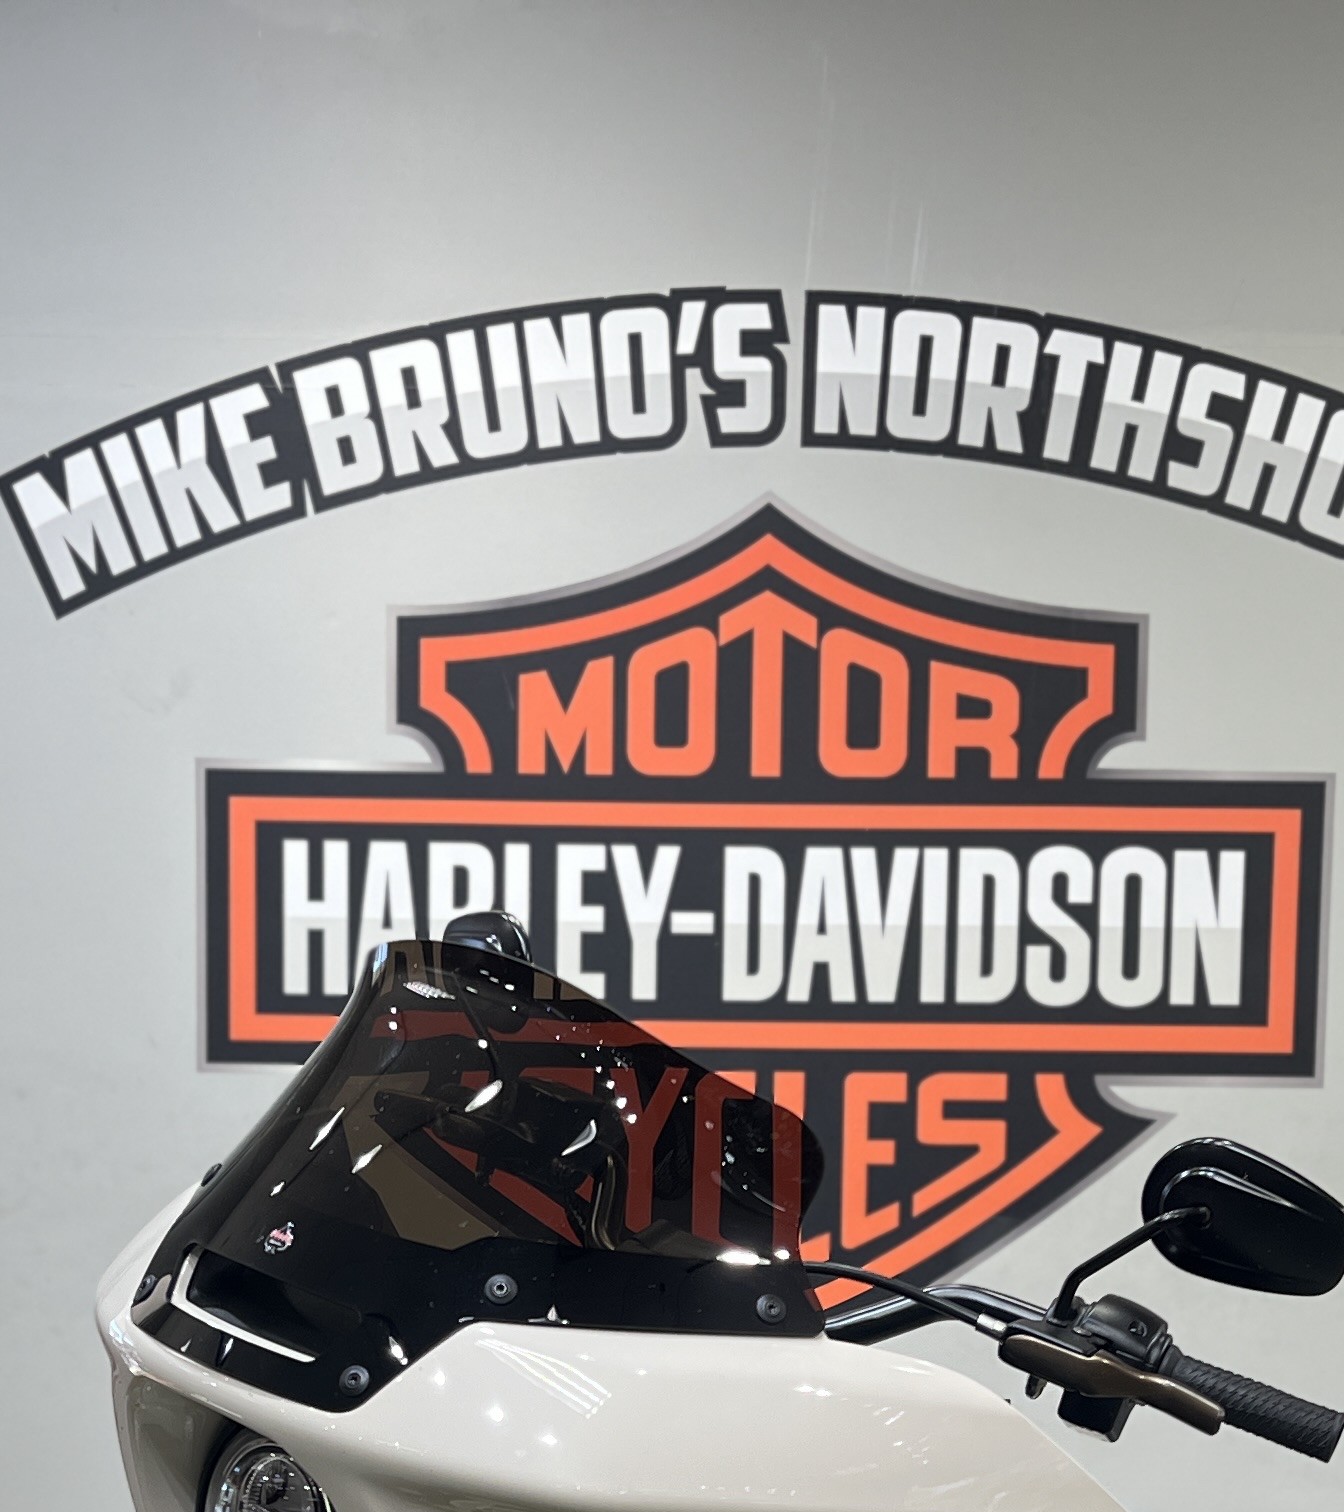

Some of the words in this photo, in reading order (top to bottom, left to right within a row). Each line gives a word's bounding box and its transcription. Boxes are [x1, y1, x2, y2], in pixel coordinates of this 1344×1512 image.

[11, 381, 294, 602] MIKE
[291, 300, 778, 498] BRUNO'S
[516, 588, 1022, 780] MOTOR
[280, 838, 1246, 1008] HARLEY-DAVIDSON
